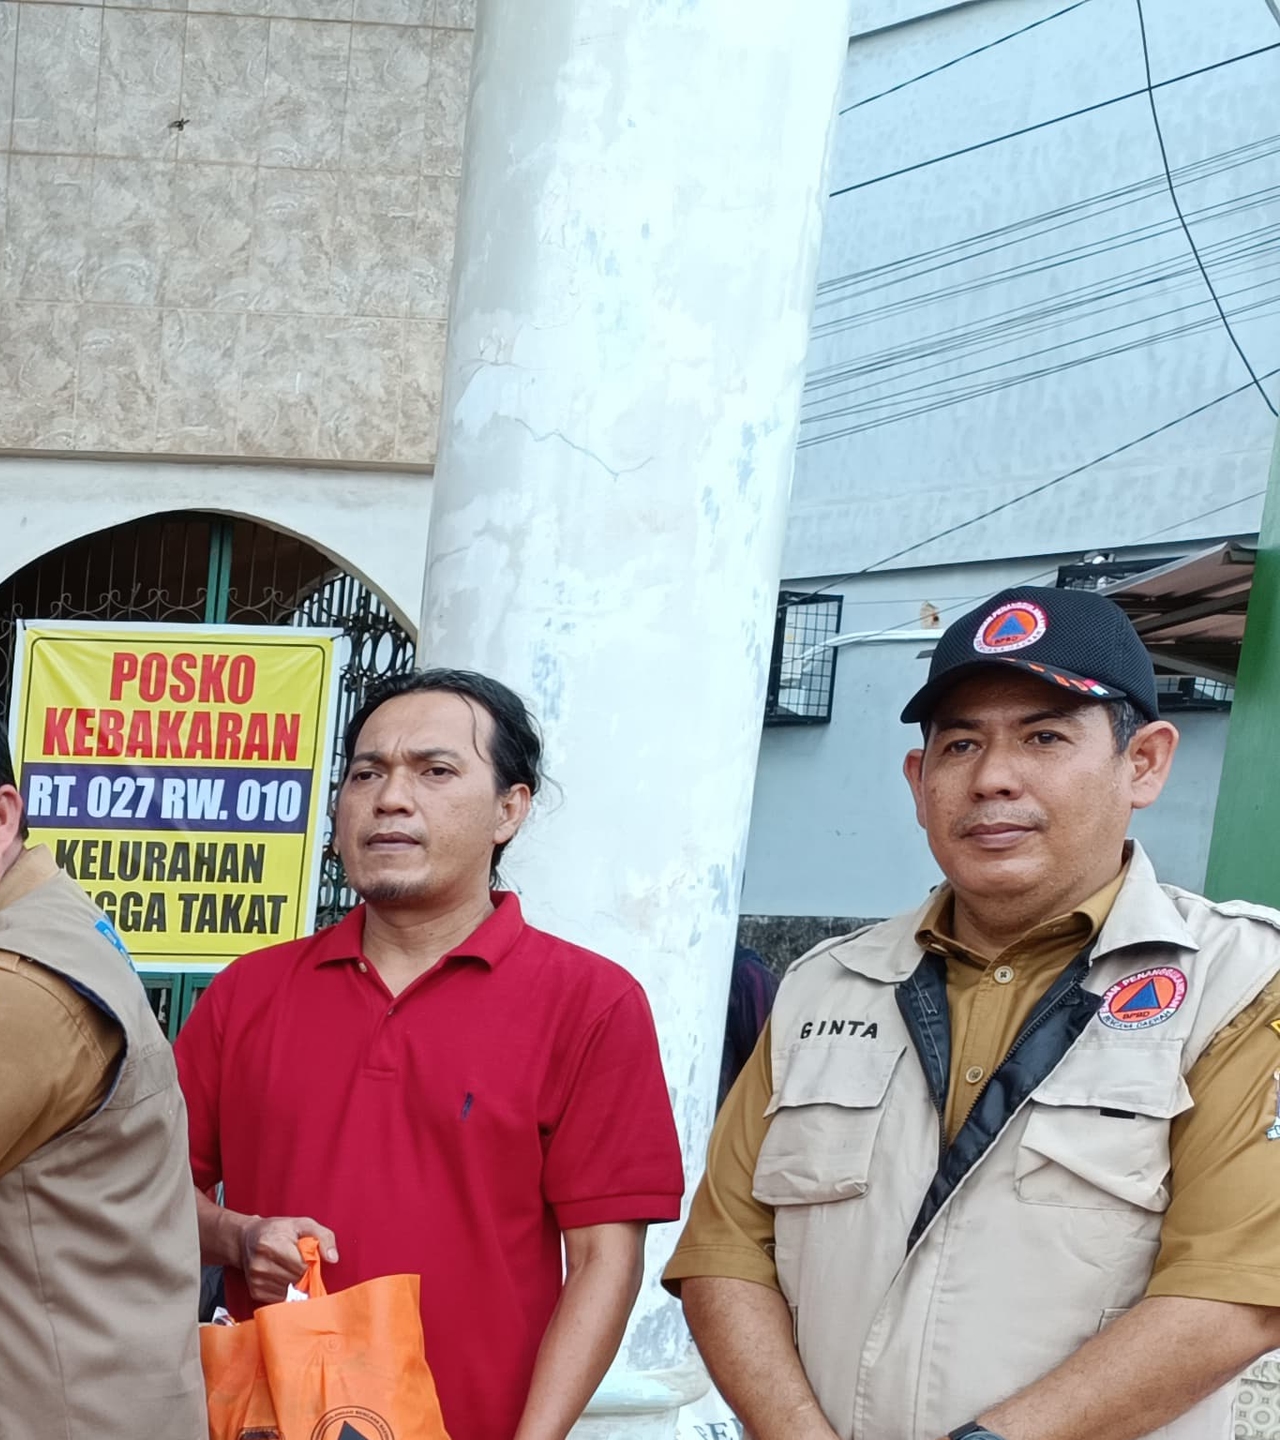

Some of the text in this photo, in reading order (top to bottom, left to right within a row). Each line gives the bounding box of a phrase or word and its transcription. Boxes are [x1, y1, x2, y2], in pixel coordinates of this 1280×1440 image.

[109, 652, 257, 704] POSKO
[42, 707, 301, 761] KEBAKARAN
[27, 775, 302, 822] RT. 027 RW. 010
[55, 839, 266, 884] KELURAHAN
[86, 891, 288, 934] GGA TAKAT
[800, 1019, 878, 1039] GINTA
[1122, 1010, 1151, 1019] BPBD
